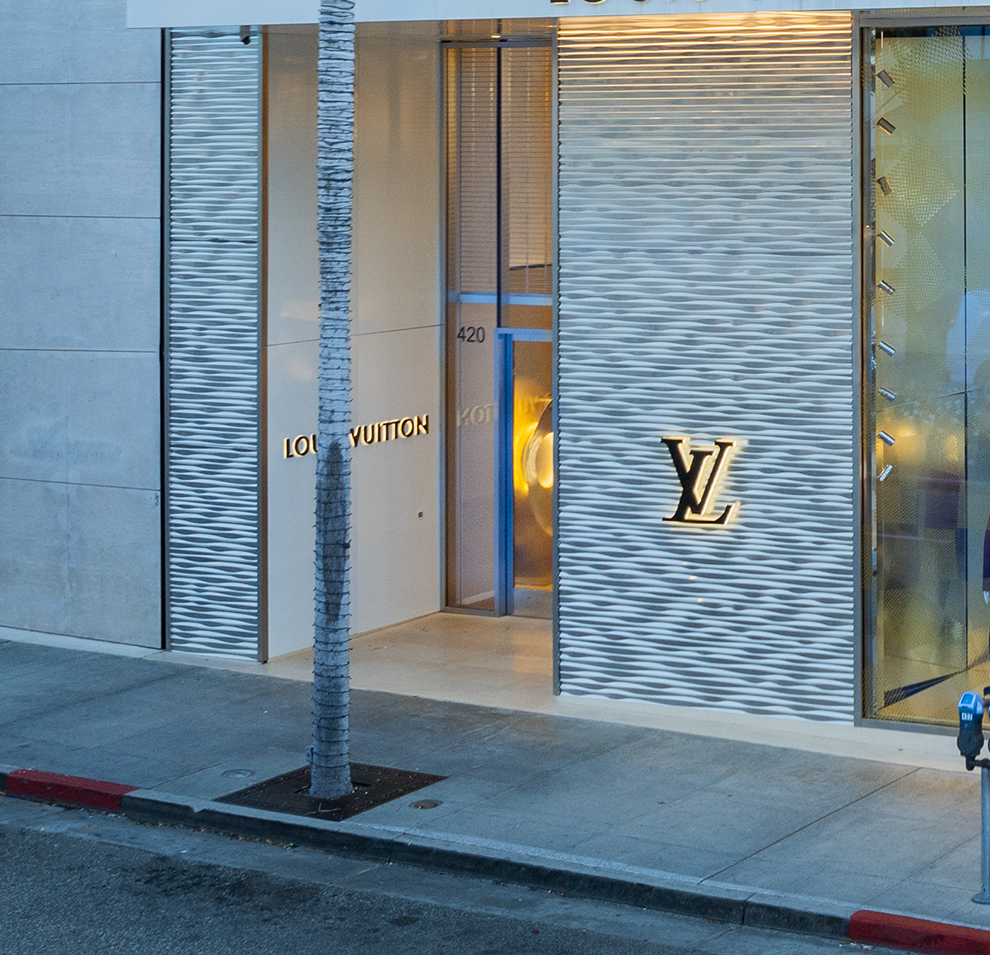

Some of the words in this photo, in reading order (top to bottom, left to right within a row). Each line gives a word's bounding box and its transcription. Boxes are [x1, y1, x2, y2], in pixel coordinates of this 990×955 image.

[457, 326, 486, 343] 420
[284, 434, 319, 459] LOU
[349, 413, 430, 448] VUITTON
